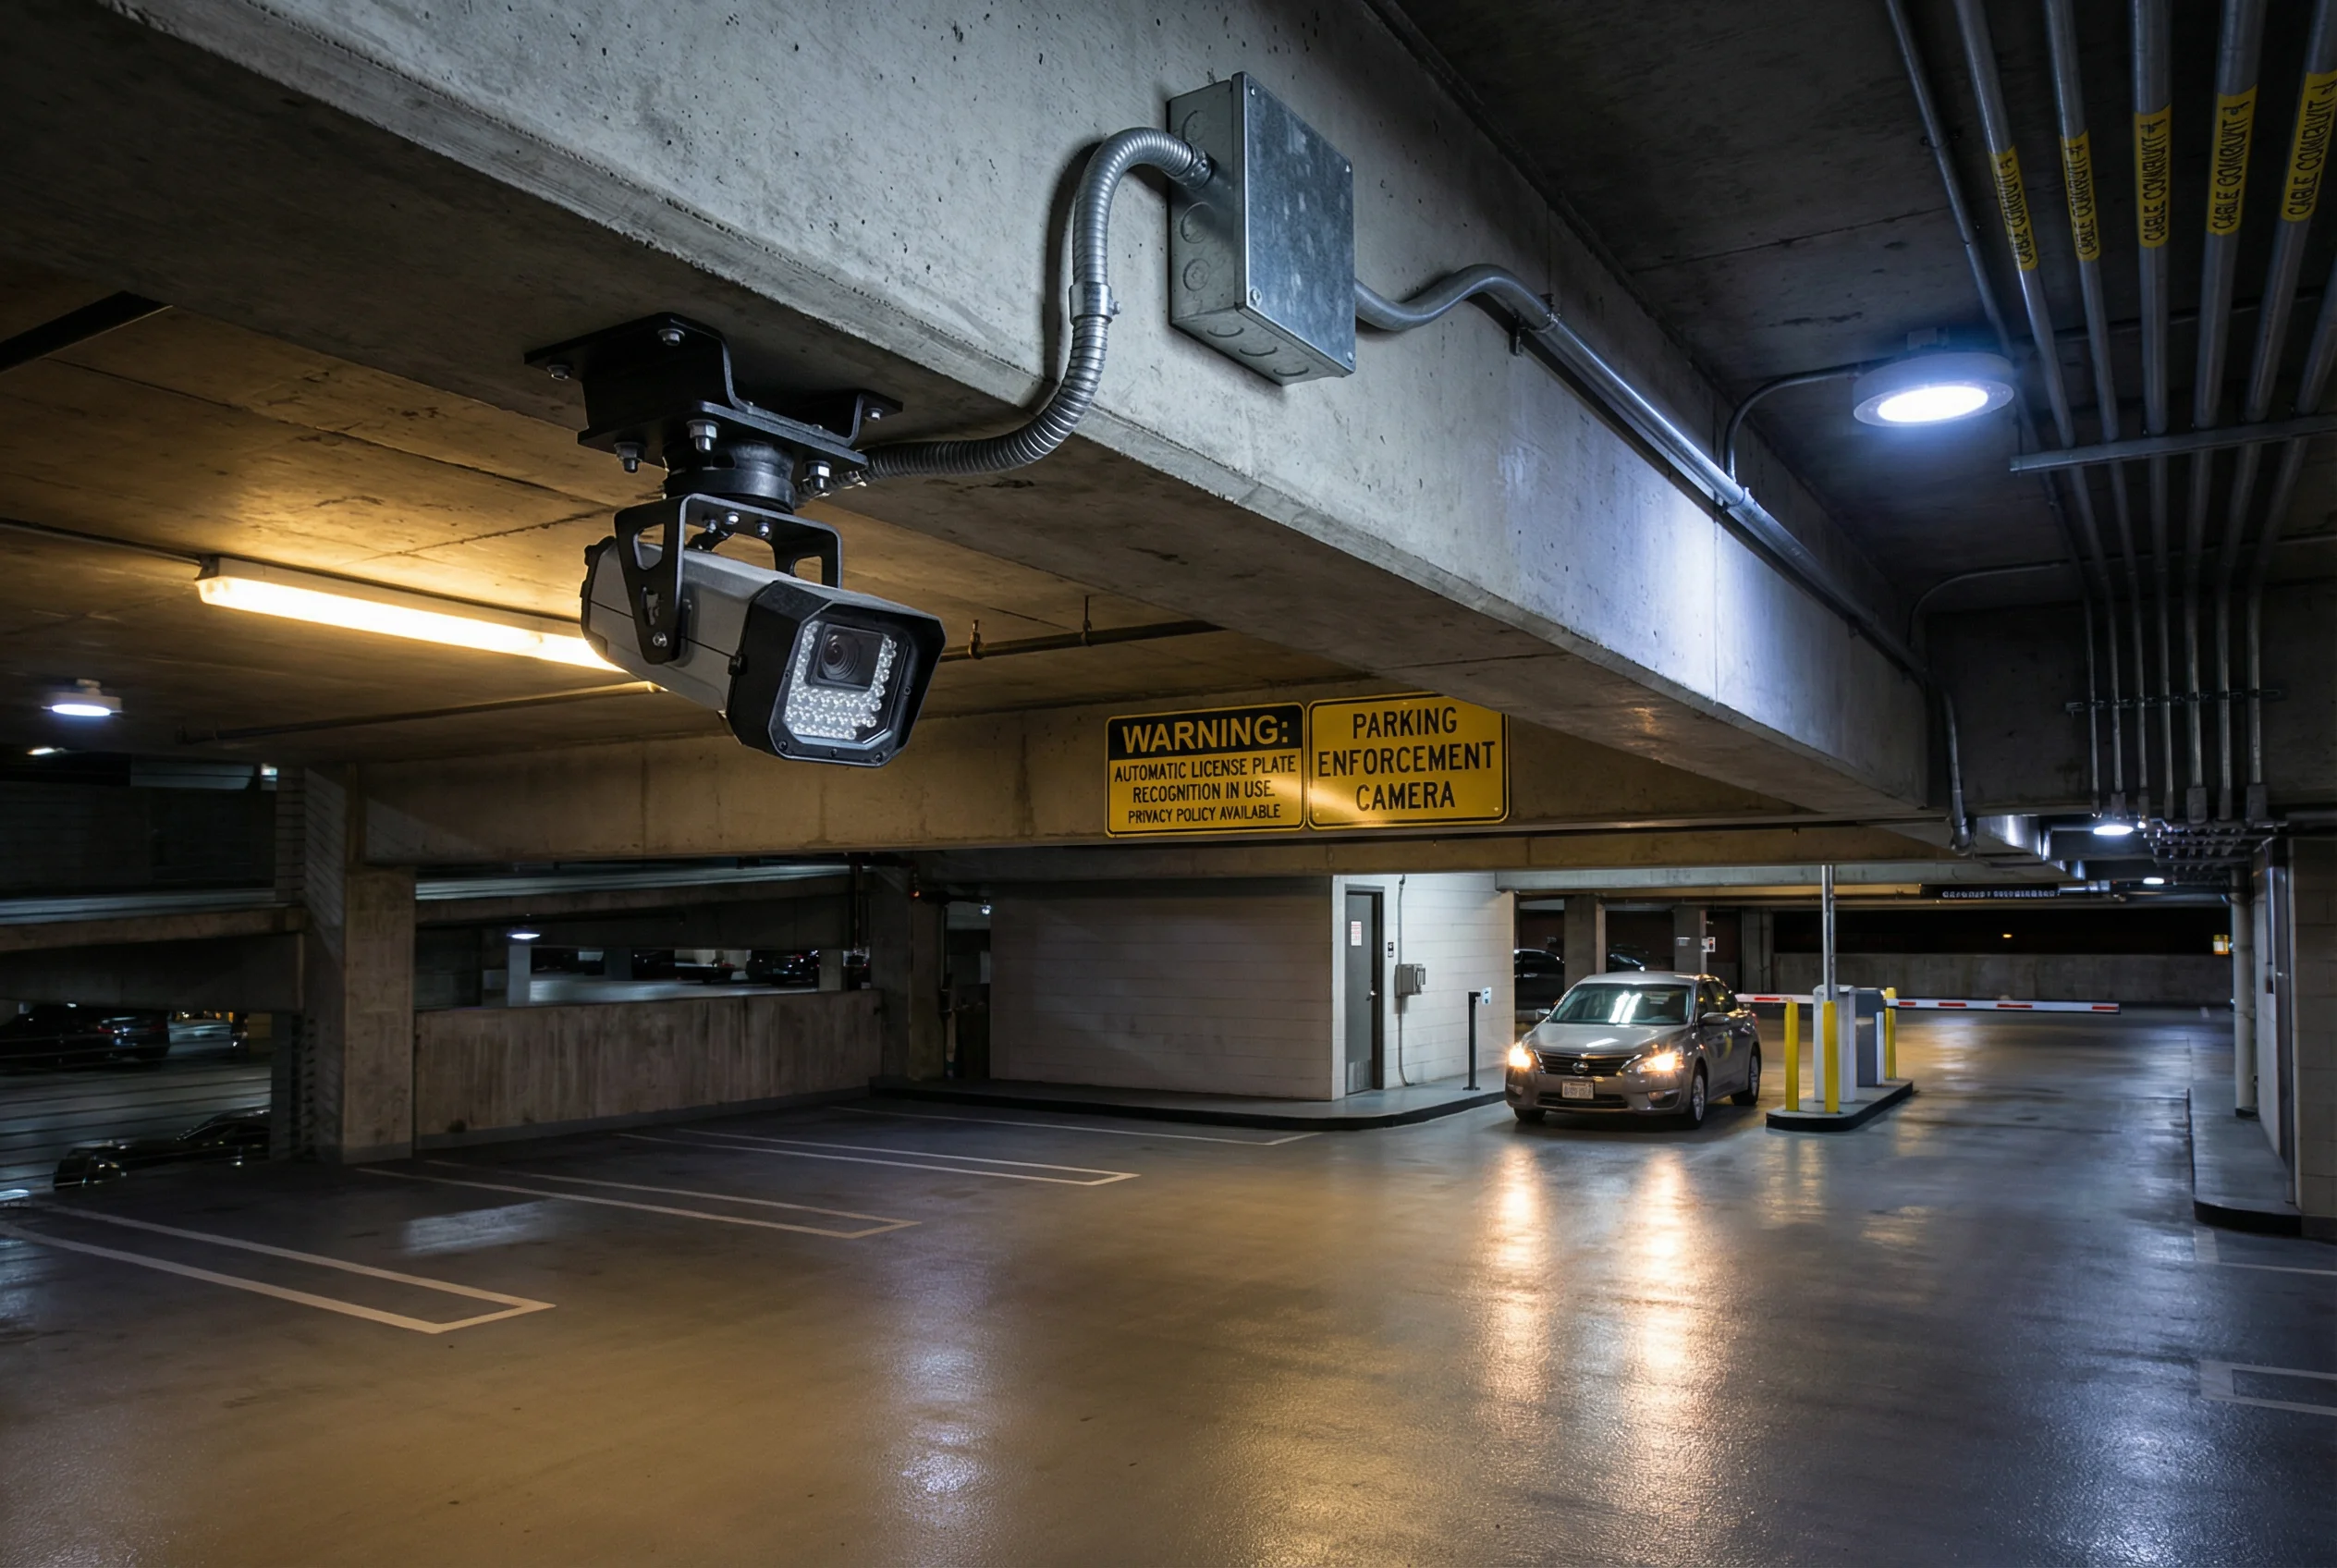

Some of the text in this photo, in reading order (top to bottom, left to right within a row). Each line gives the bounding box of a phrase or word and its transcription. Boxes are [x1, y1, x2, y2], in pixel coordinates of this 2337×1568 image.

[2212, 189, 2240, 229] CABLE
[2287, 172, 2319, 214] CABLE
[2144, 201, 2166, 241] CABLE
[1122, 715, 1289, 753] WARNING:
[1352, 706, 1457, 739] PARKING
[1114, 755, 1296, 782] AUTOMATIC LICENSE PLATE
[1318, 741, 1496, 778] ENFORCEMENT
[1132, 783, 1221, 803] RECOGNITION
[1226, 782, 1240, 800] IN
[1355, 780, 1456, 812] CAMERA
[1128, 803, 1281, 824] PRIVACY POLICY AVAILABLE
